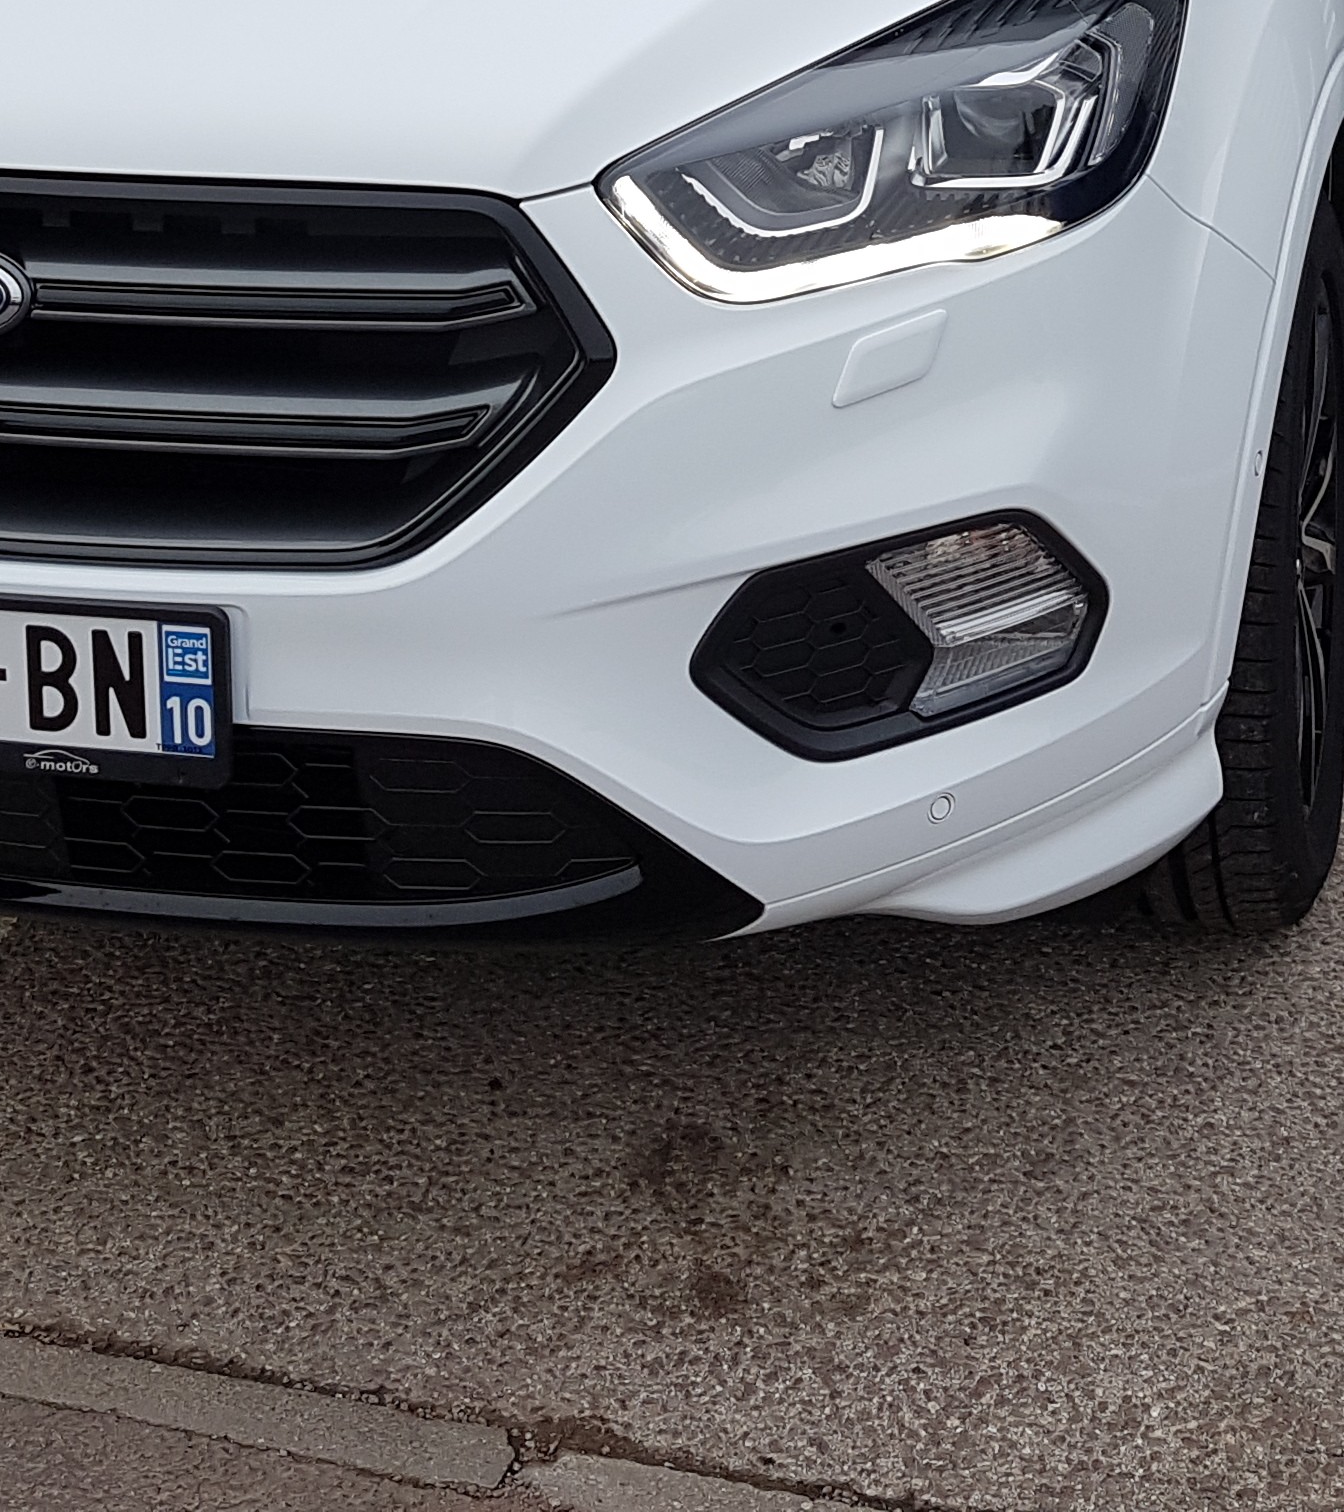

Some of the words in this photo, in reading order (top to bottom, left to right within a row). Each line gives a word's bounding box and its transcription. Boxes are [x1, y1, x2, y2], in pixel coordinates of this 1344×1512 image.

[167, 635, 206, 649] Grand
[167, 648, 207, 672] Est
[166, 696, 212, 746] 10
